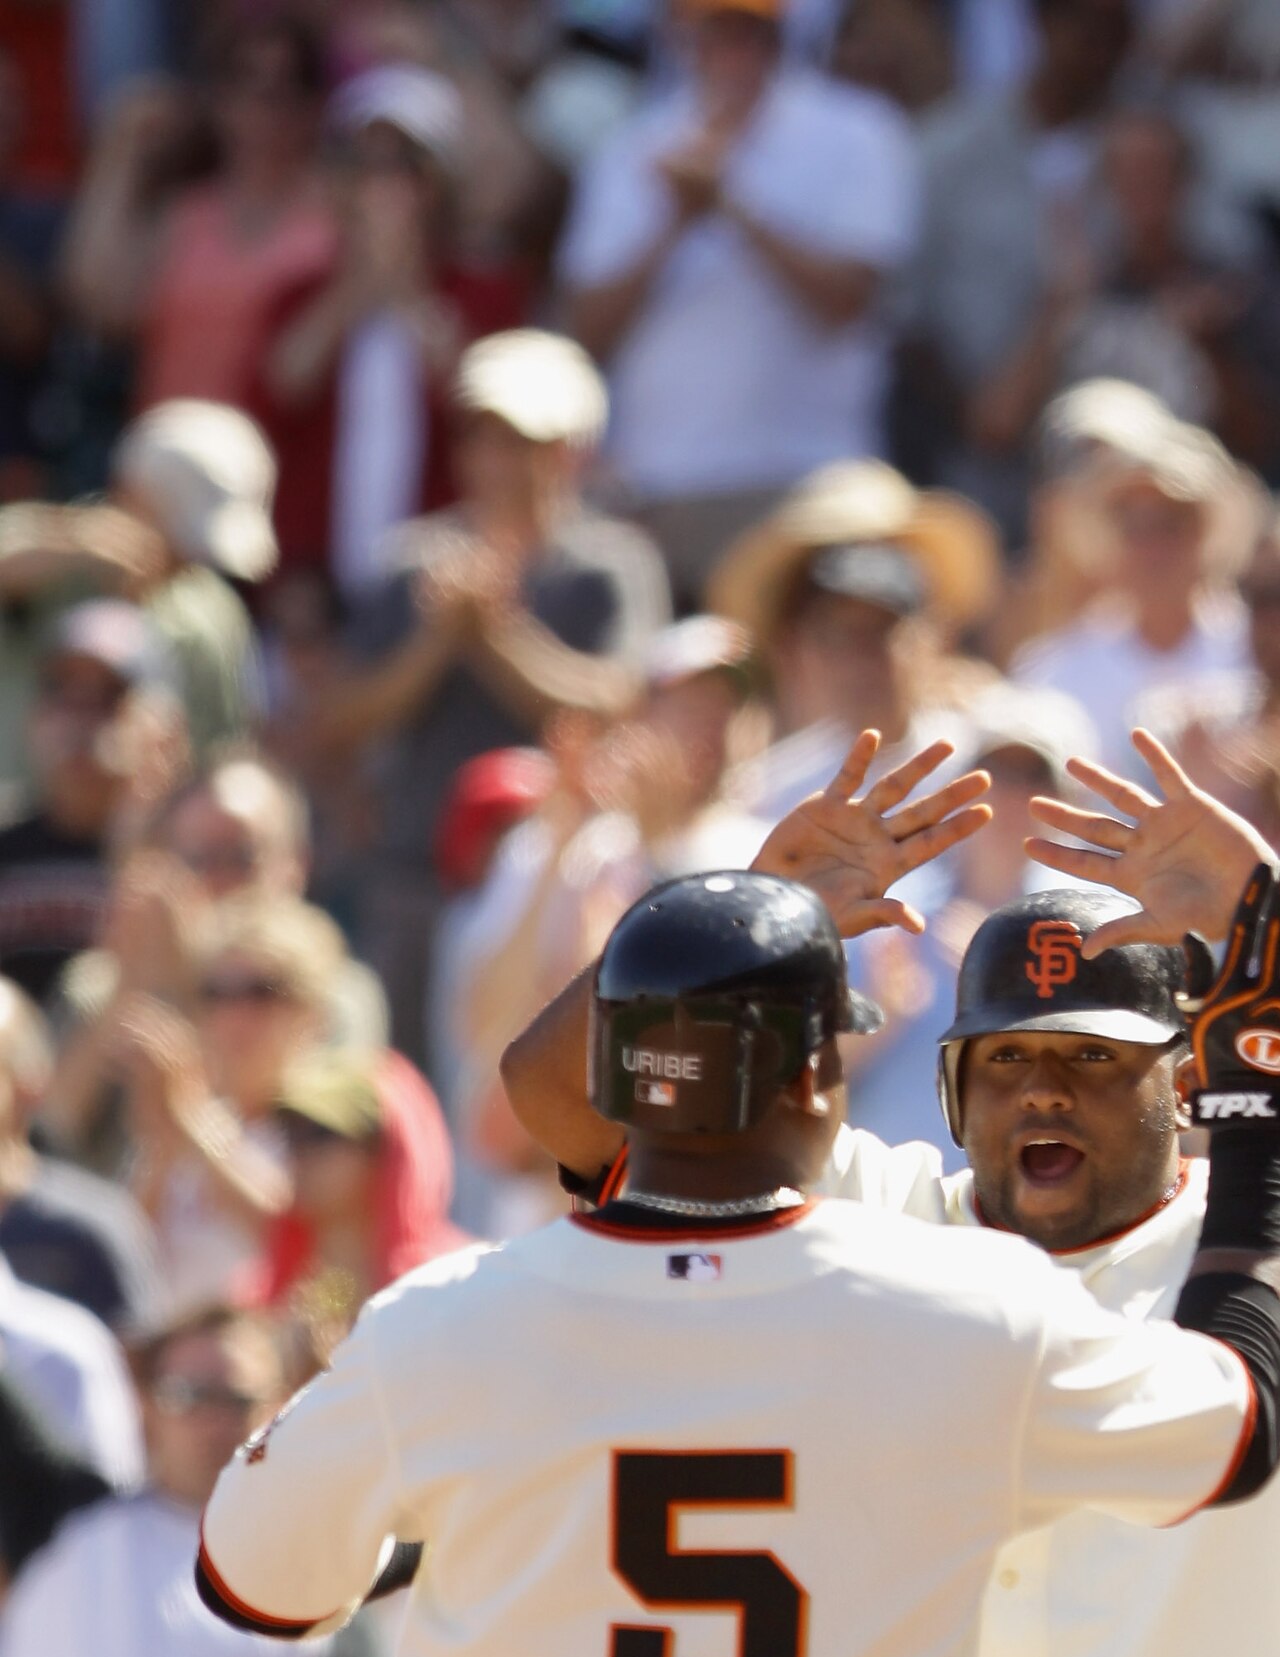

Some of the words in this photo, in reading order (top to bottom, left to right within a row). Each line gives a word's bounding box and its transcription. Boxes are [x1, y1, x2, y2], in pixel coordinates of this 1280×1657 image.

[1025, 920, 1082, 998] SF
[622, 1046, 702, 1080] URIBE
[1199, 1093, 1277, 1119] TPX
